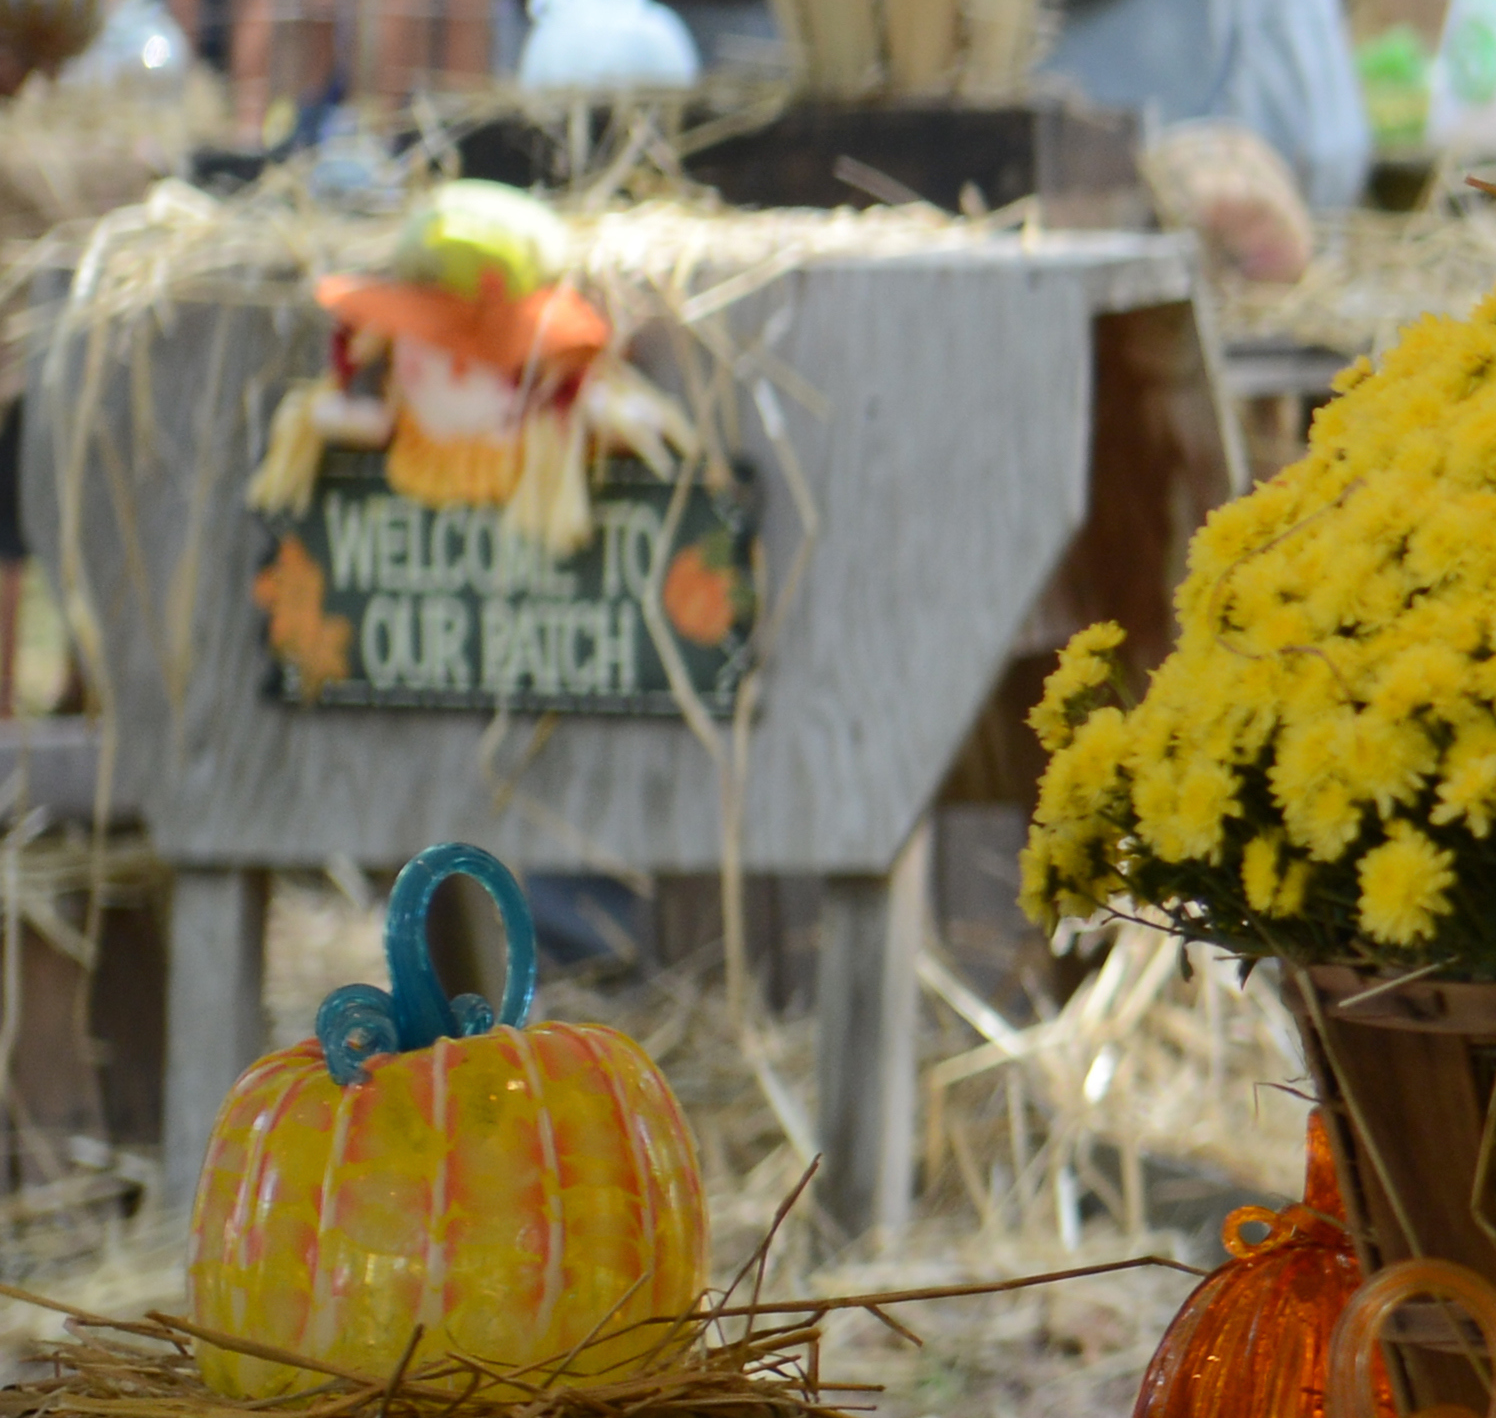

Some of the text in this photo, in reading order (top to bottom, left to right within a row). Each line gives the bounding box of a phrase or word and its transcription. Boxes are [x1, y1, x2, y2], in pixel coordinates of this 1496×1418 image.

[596, 499, 664, 597] TO
[361, 595, 638, 696] OUR PATCH
